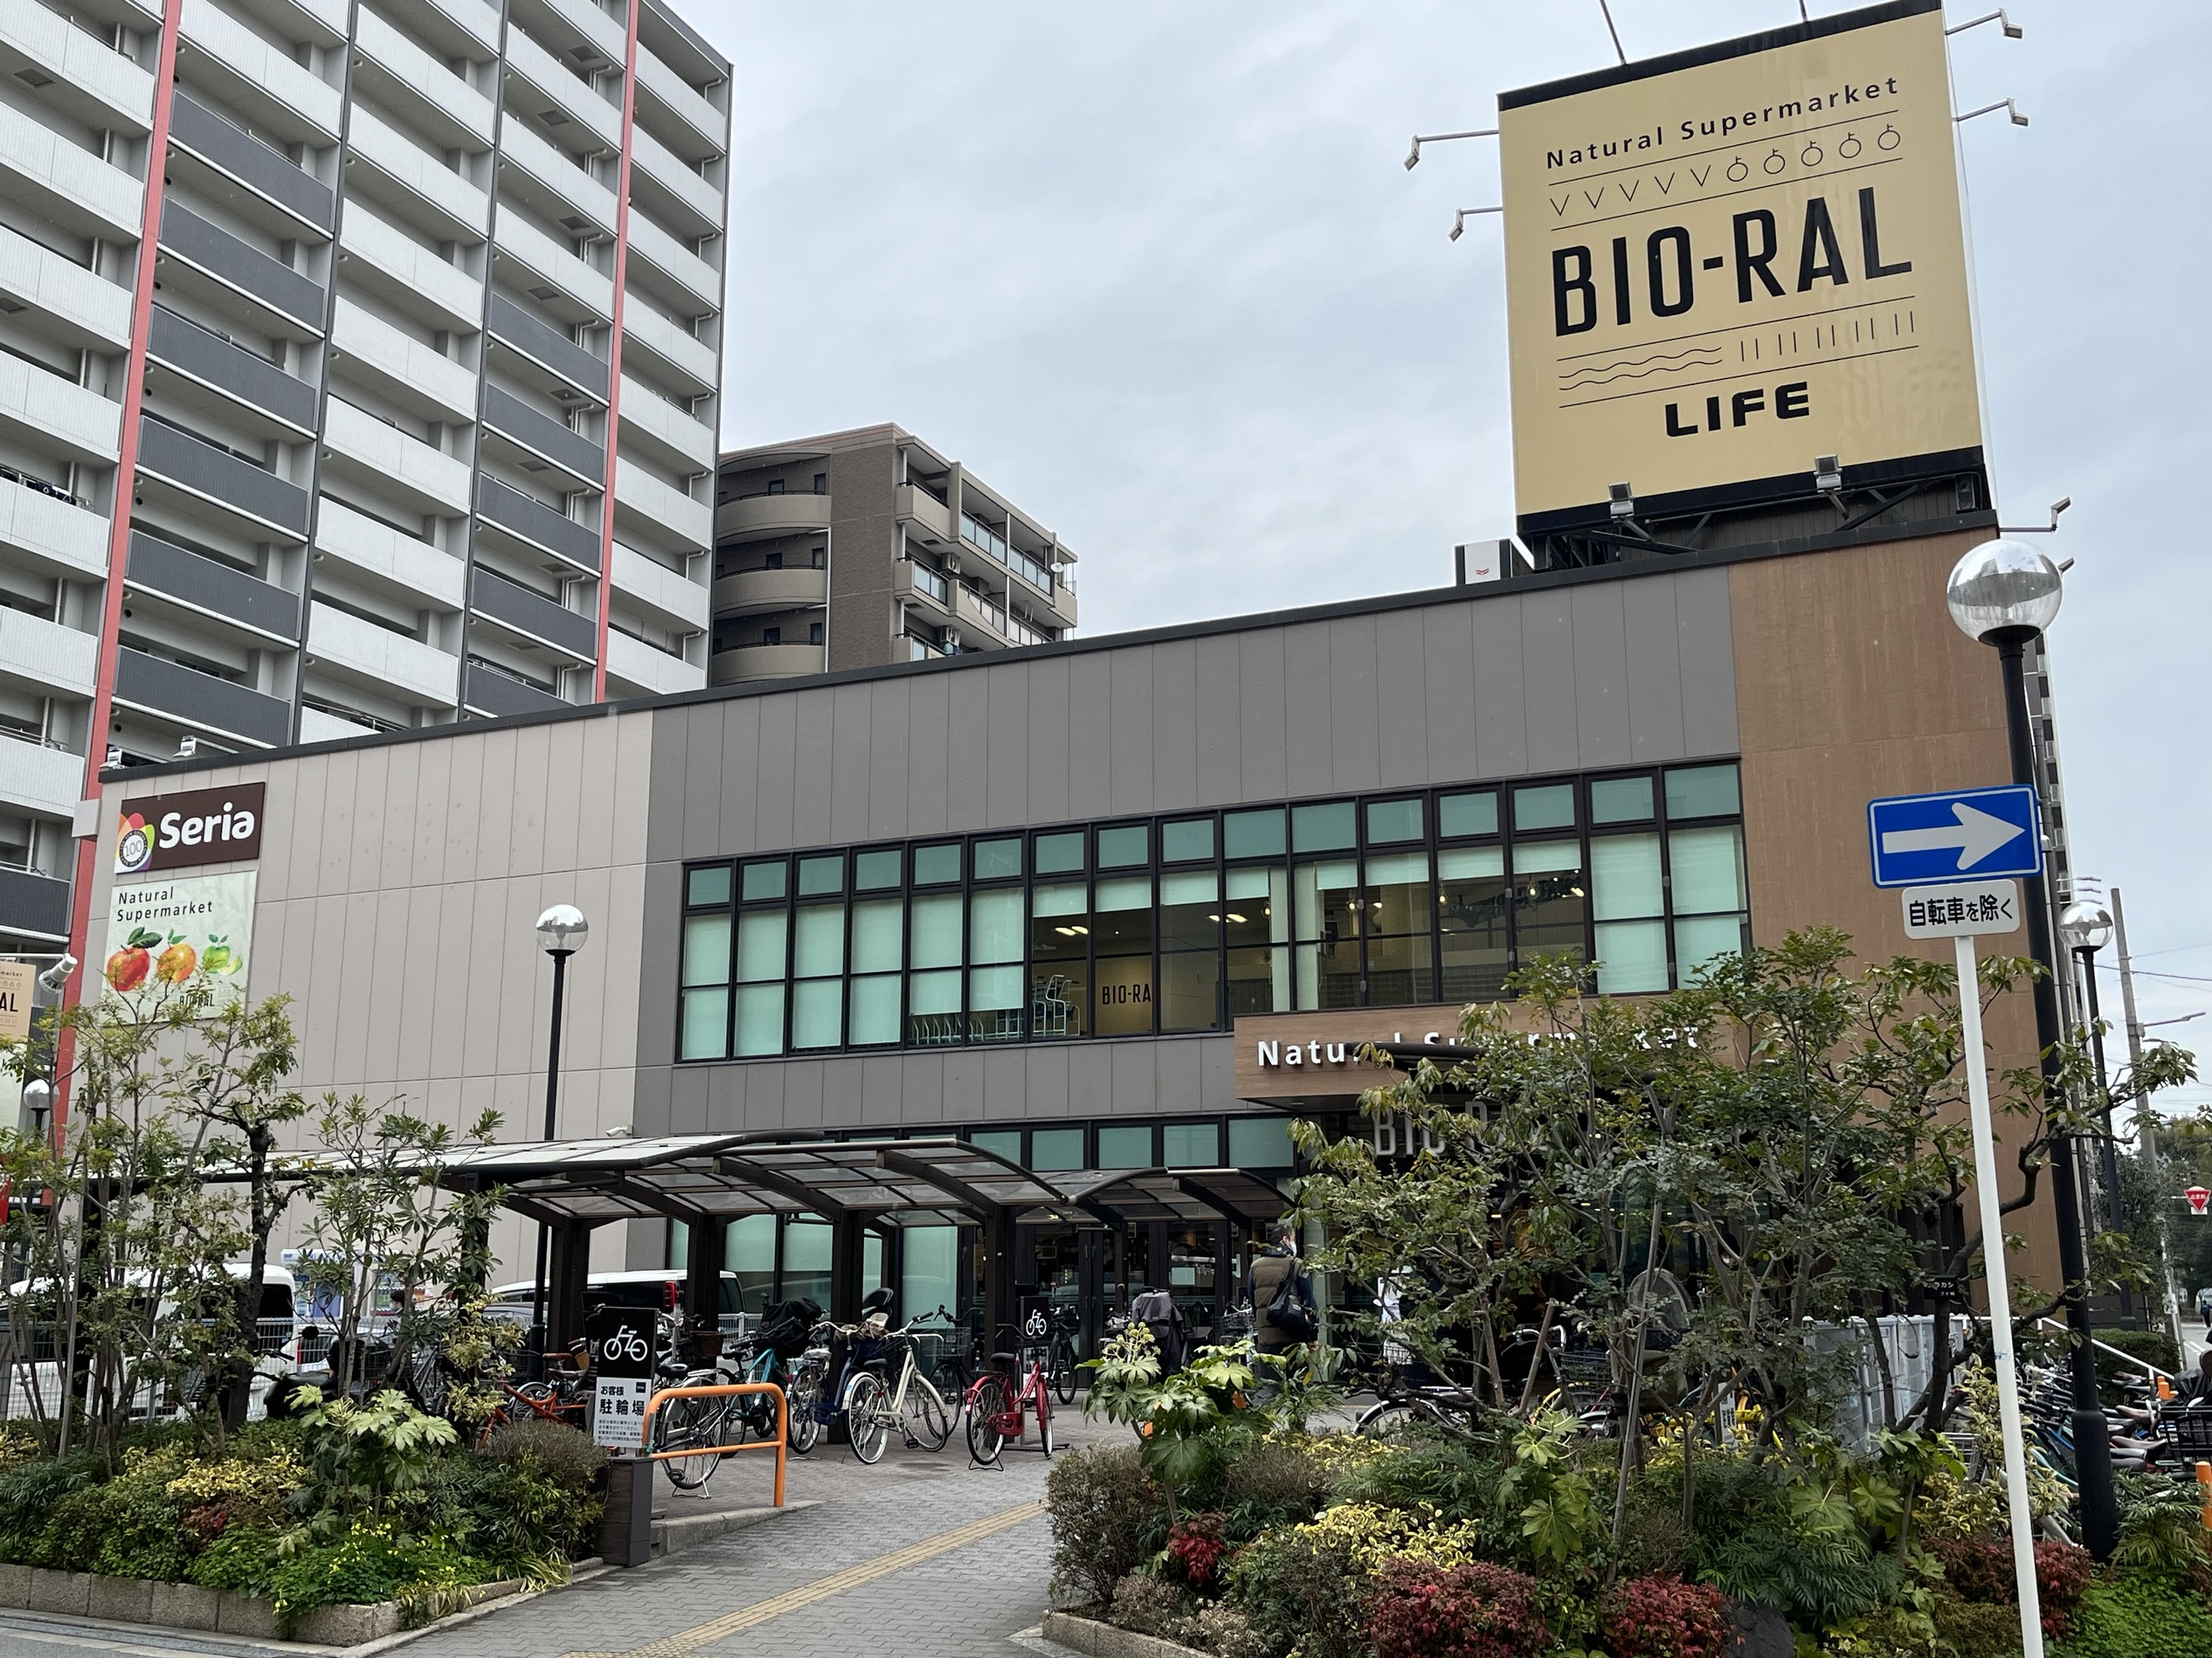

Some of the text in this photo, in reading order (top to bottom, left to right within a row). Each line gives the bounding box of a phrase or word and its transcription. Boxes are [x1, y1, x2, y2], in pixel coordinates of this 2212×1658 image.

[1546, 76, 1898, 169] Natural Supermarket
[1552, 186, 1912, 337] BIO-RAL
[1665, 382, 1810, 437] LIFE
[159, 802, 255, 849] Seria
[125, 839, 142, 858] 100
[118, 886, 174, 905] Natural
[117, 901, 212, 923] Supermarket
[1910, 894, 2013, 927] 自転車を除く
[600, 1385, 625, 1396] お客様
[598, 1399, 645, 1416] 駐輪場
